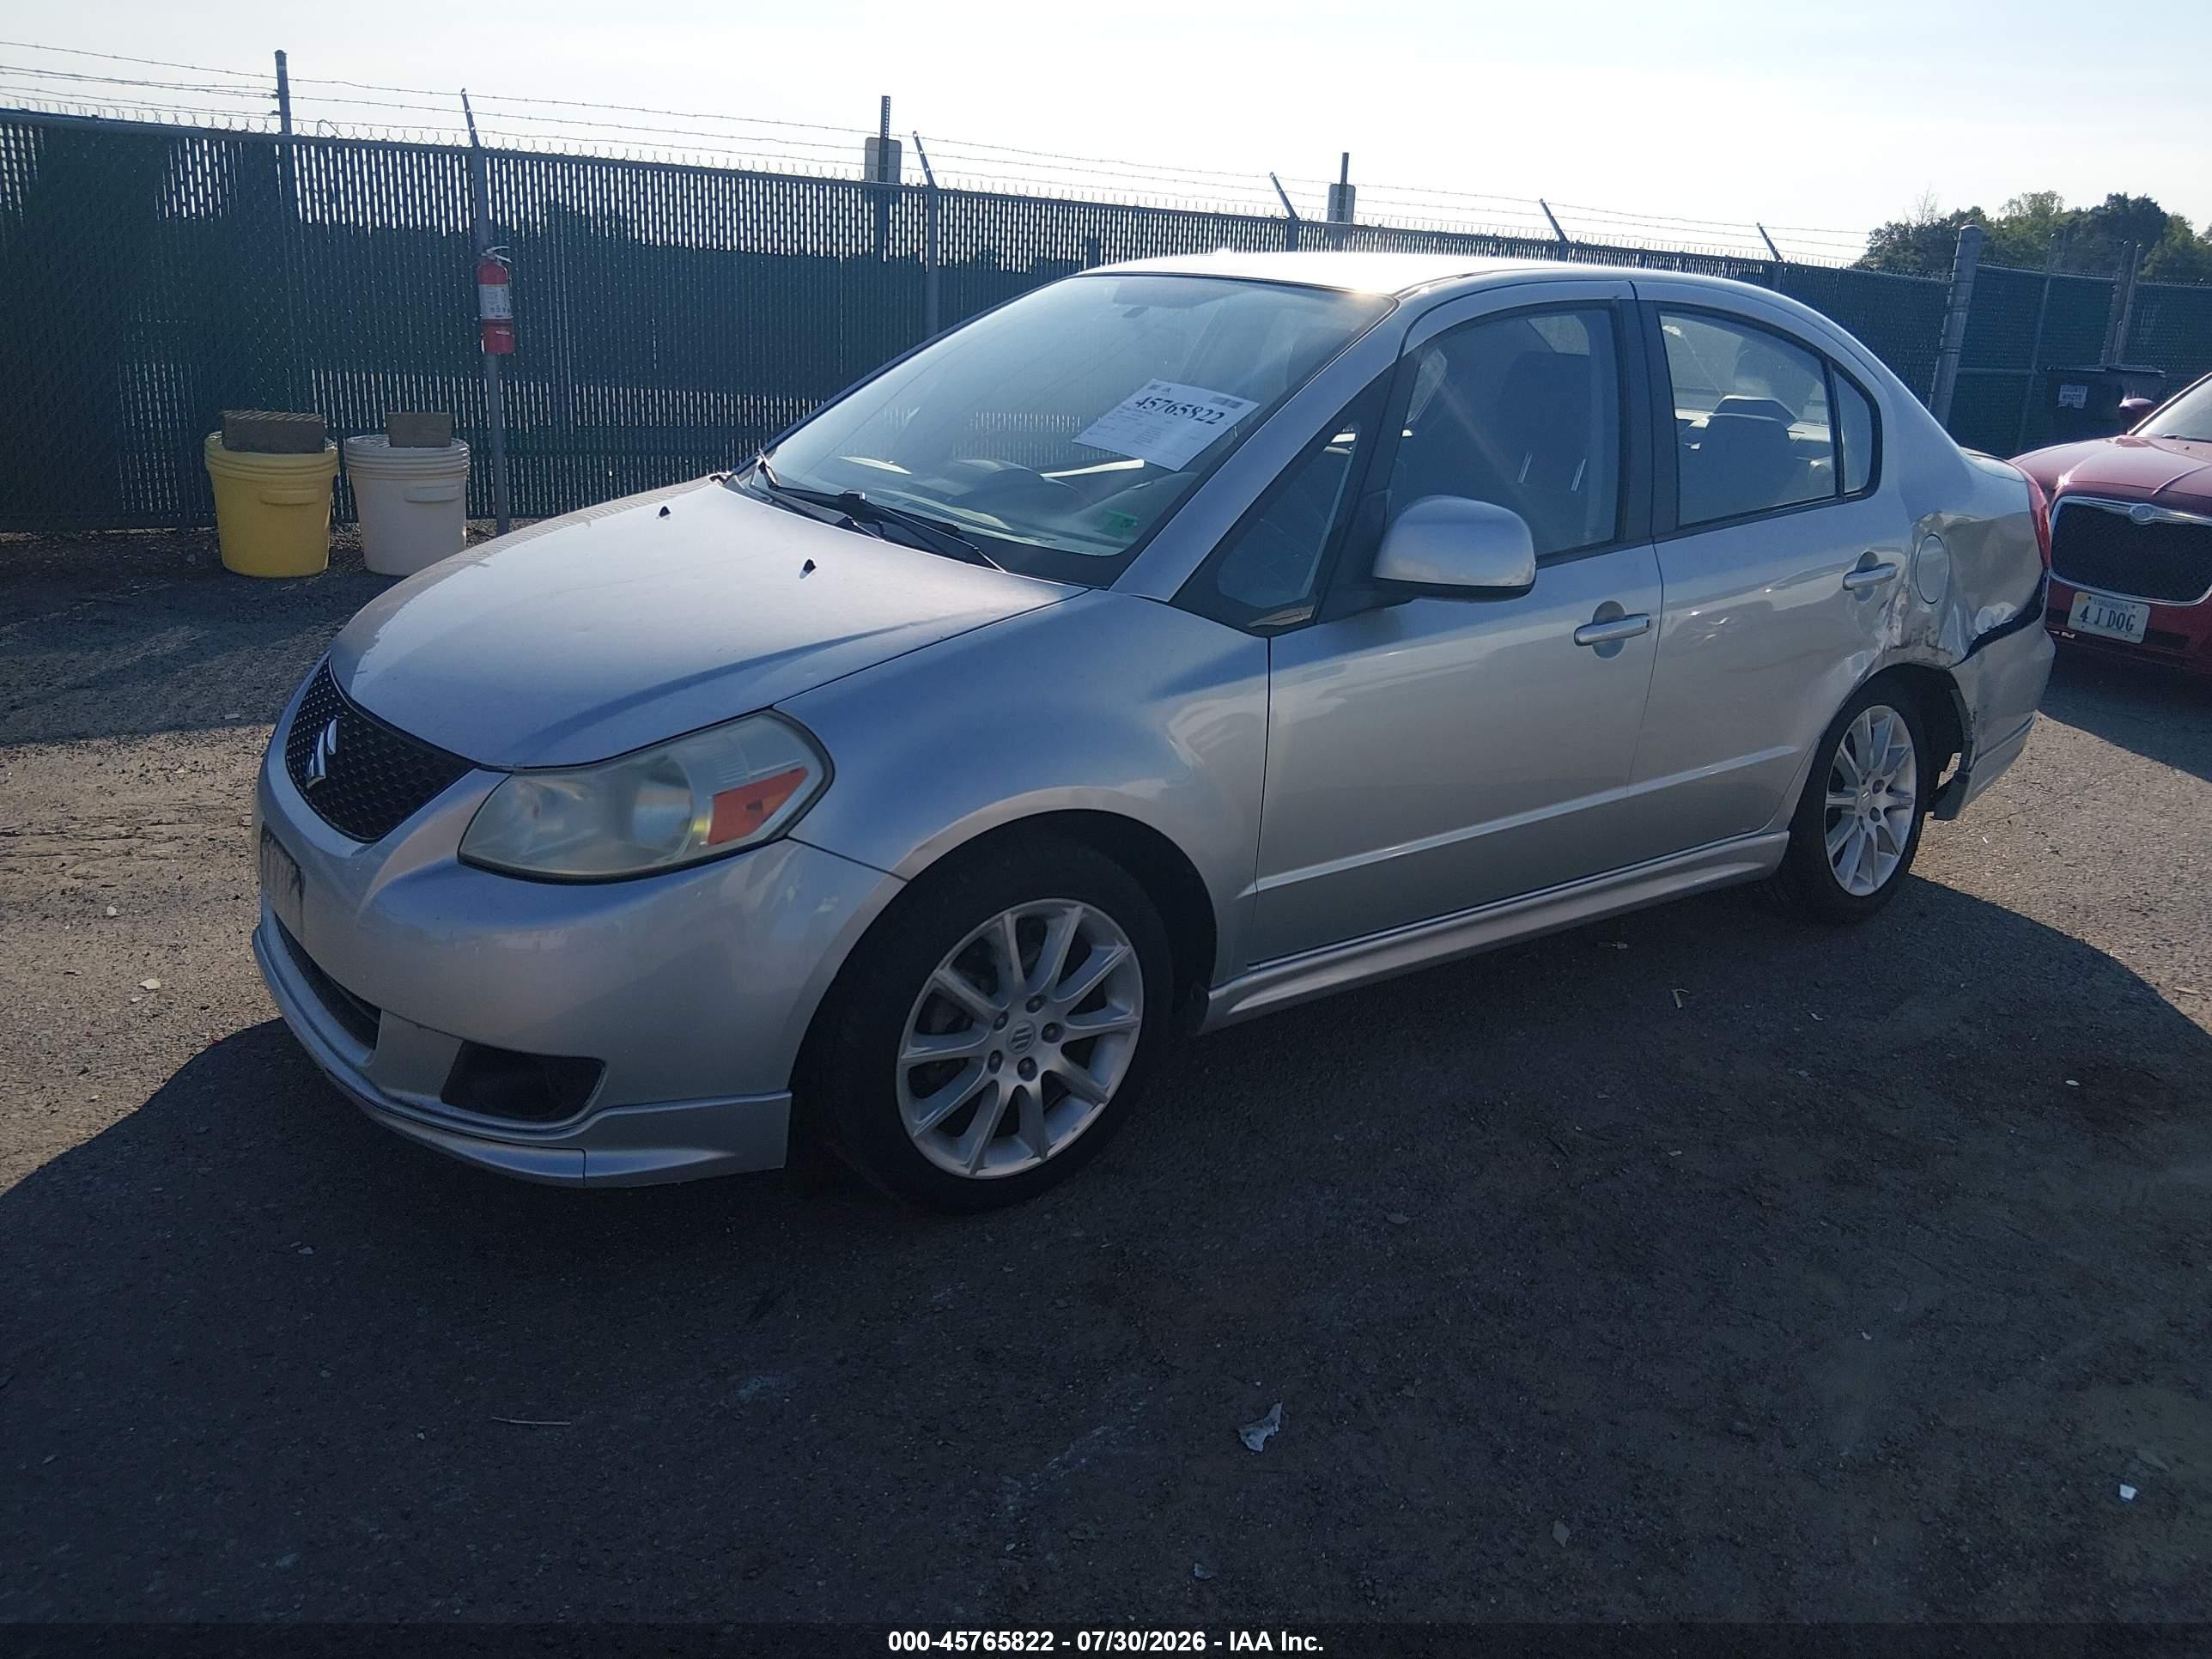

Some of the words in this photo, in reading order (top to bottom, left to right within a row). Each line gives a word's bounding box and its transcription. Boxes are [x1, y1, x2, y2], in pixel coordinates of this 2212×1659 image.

[1135, 396, 1226, 425] 45765822
[2080, 605, 2089, 623] 4
[2094, 607, 2103, 625] J
[2106, 610, 2136, 632] DOG
